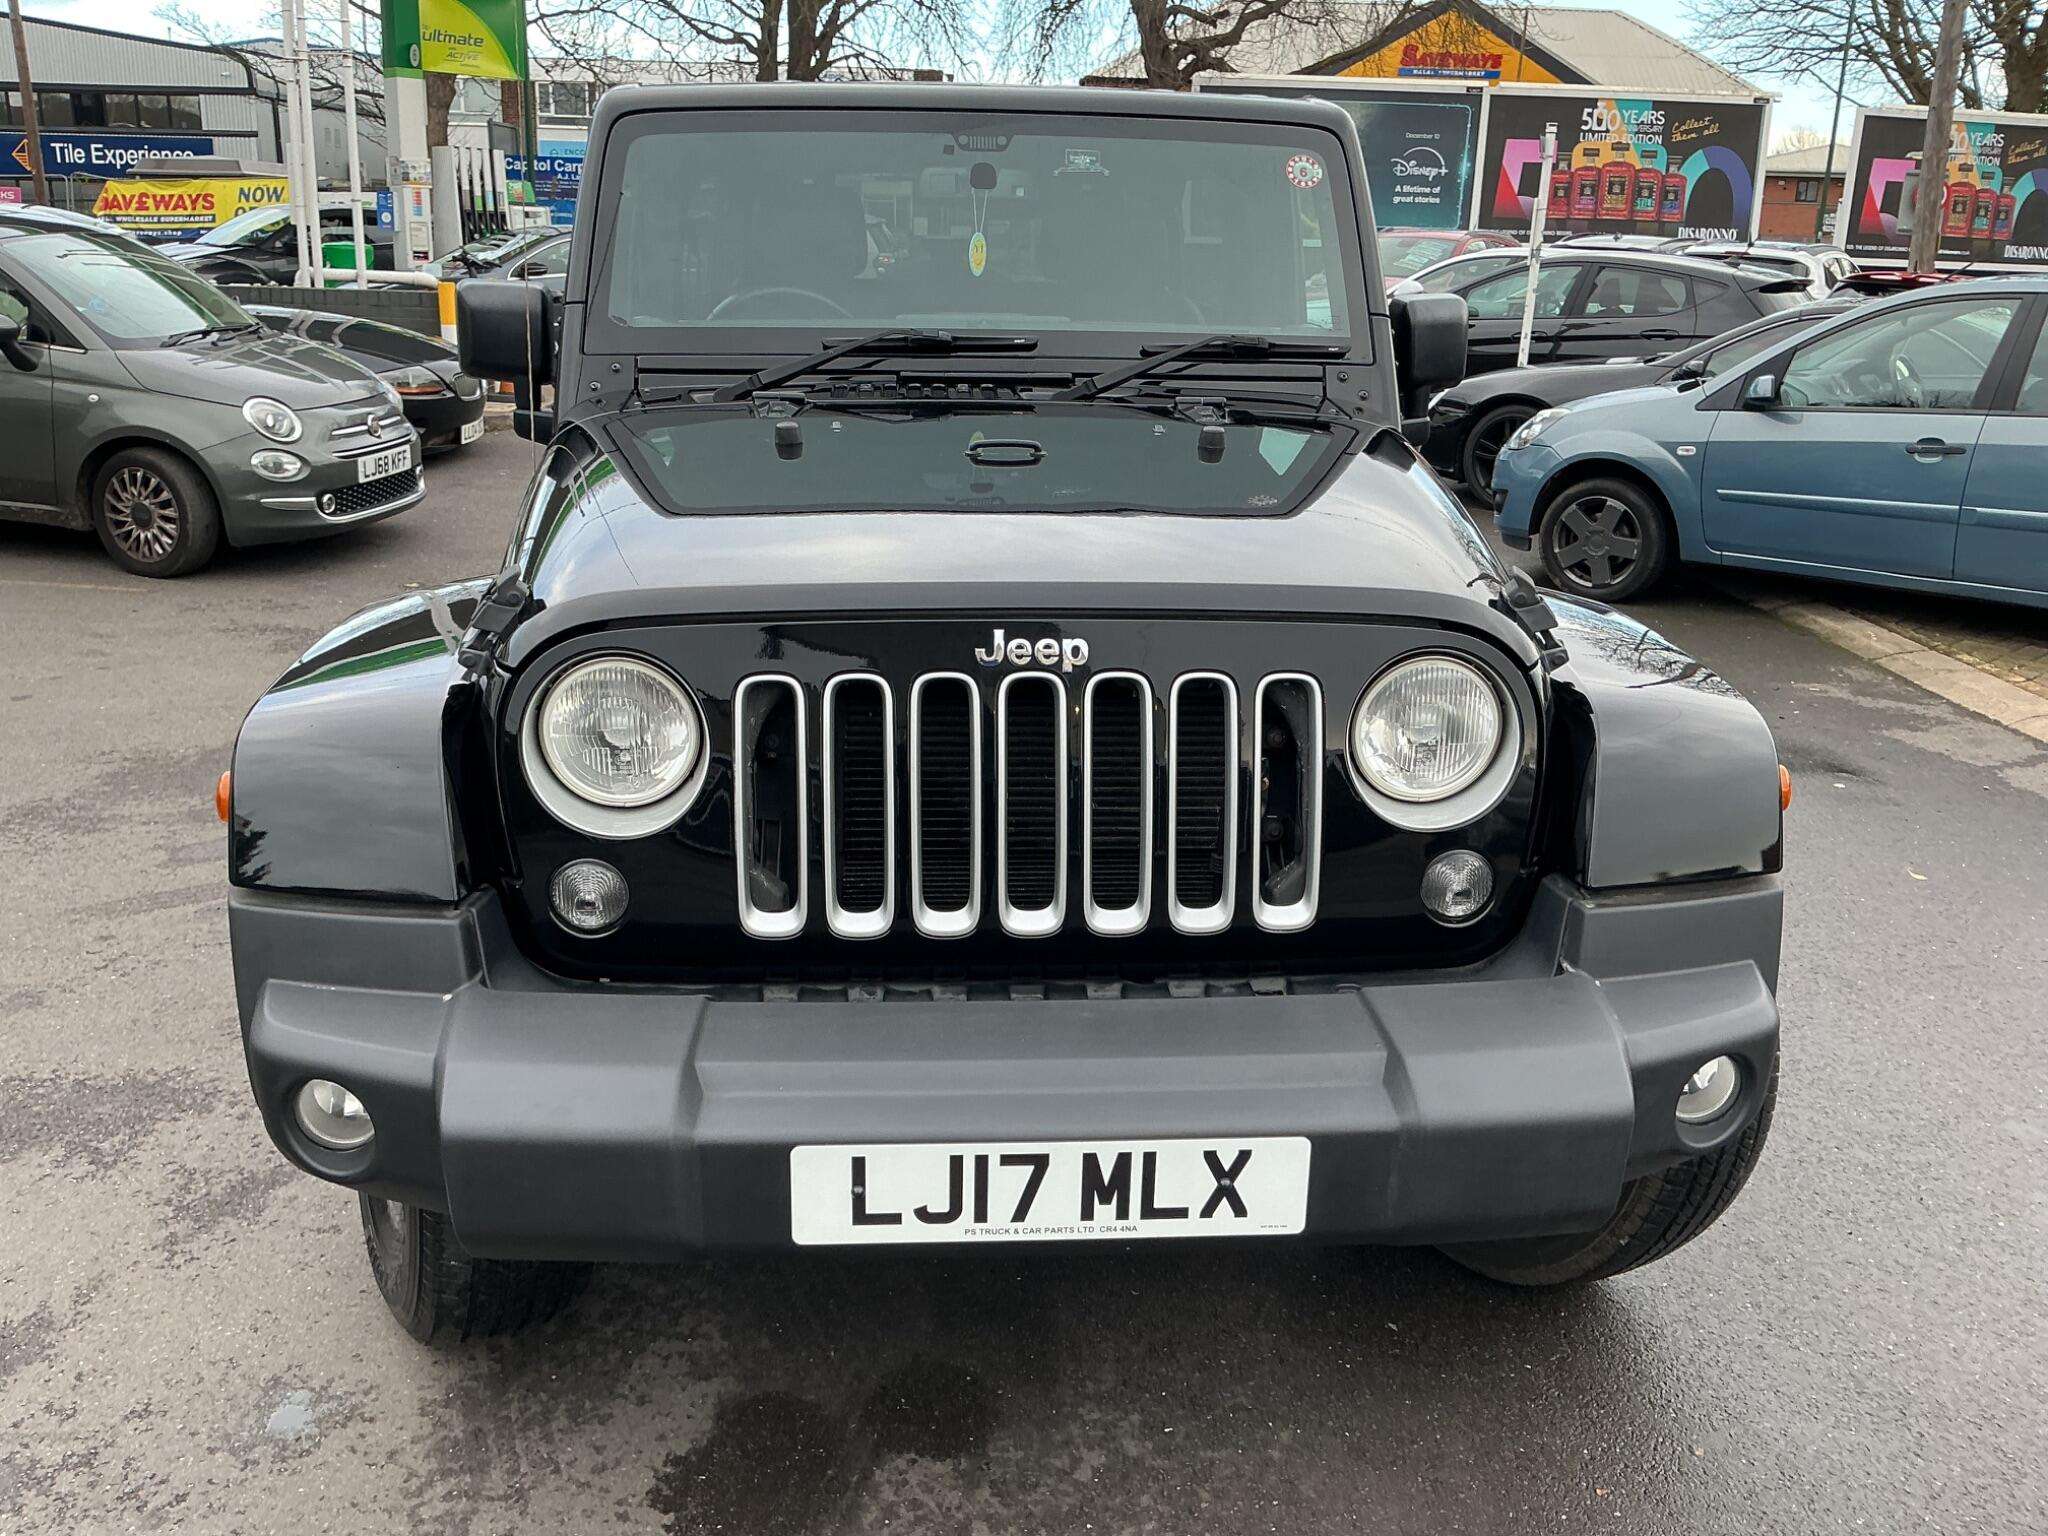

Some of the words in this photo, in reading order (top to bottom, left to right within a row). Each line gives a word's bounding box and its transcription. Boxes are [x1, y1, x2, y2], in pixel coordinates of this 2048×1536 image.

[422, 29, 484, 47] ultimate
[1622, 110, 1665, 124] YEARS
[1580, 132, 1619, 143] LIMITED
[1970, 132, 2005, 147] YEARS
[50, 142, 85, 164] Tile
[505, 157, 551, 173] Captol
[238, 186, 284, 203] NOW
[1402, 185, 1431, 193] lifetime
[1678, 227, 1737, 241] DISARONNO
[363, 455, 389, 478] LJ68
[974, 629, 1089, 673] Jeep
[851, 1153, 1050, 1226] LJ17
[1079, 1149, 1253, 1222] MLX
[964, 1228, 976, 1236] PS
[979, 1227, 1011, 1235] TRUCK
[1013, 1227, 1020, 1235] &
[1022, 1227, 1041, 1235] CAR
[1044, 1226, 1075, 1234] PARTS
[1099, 1225, 1117, 1233] CR4
